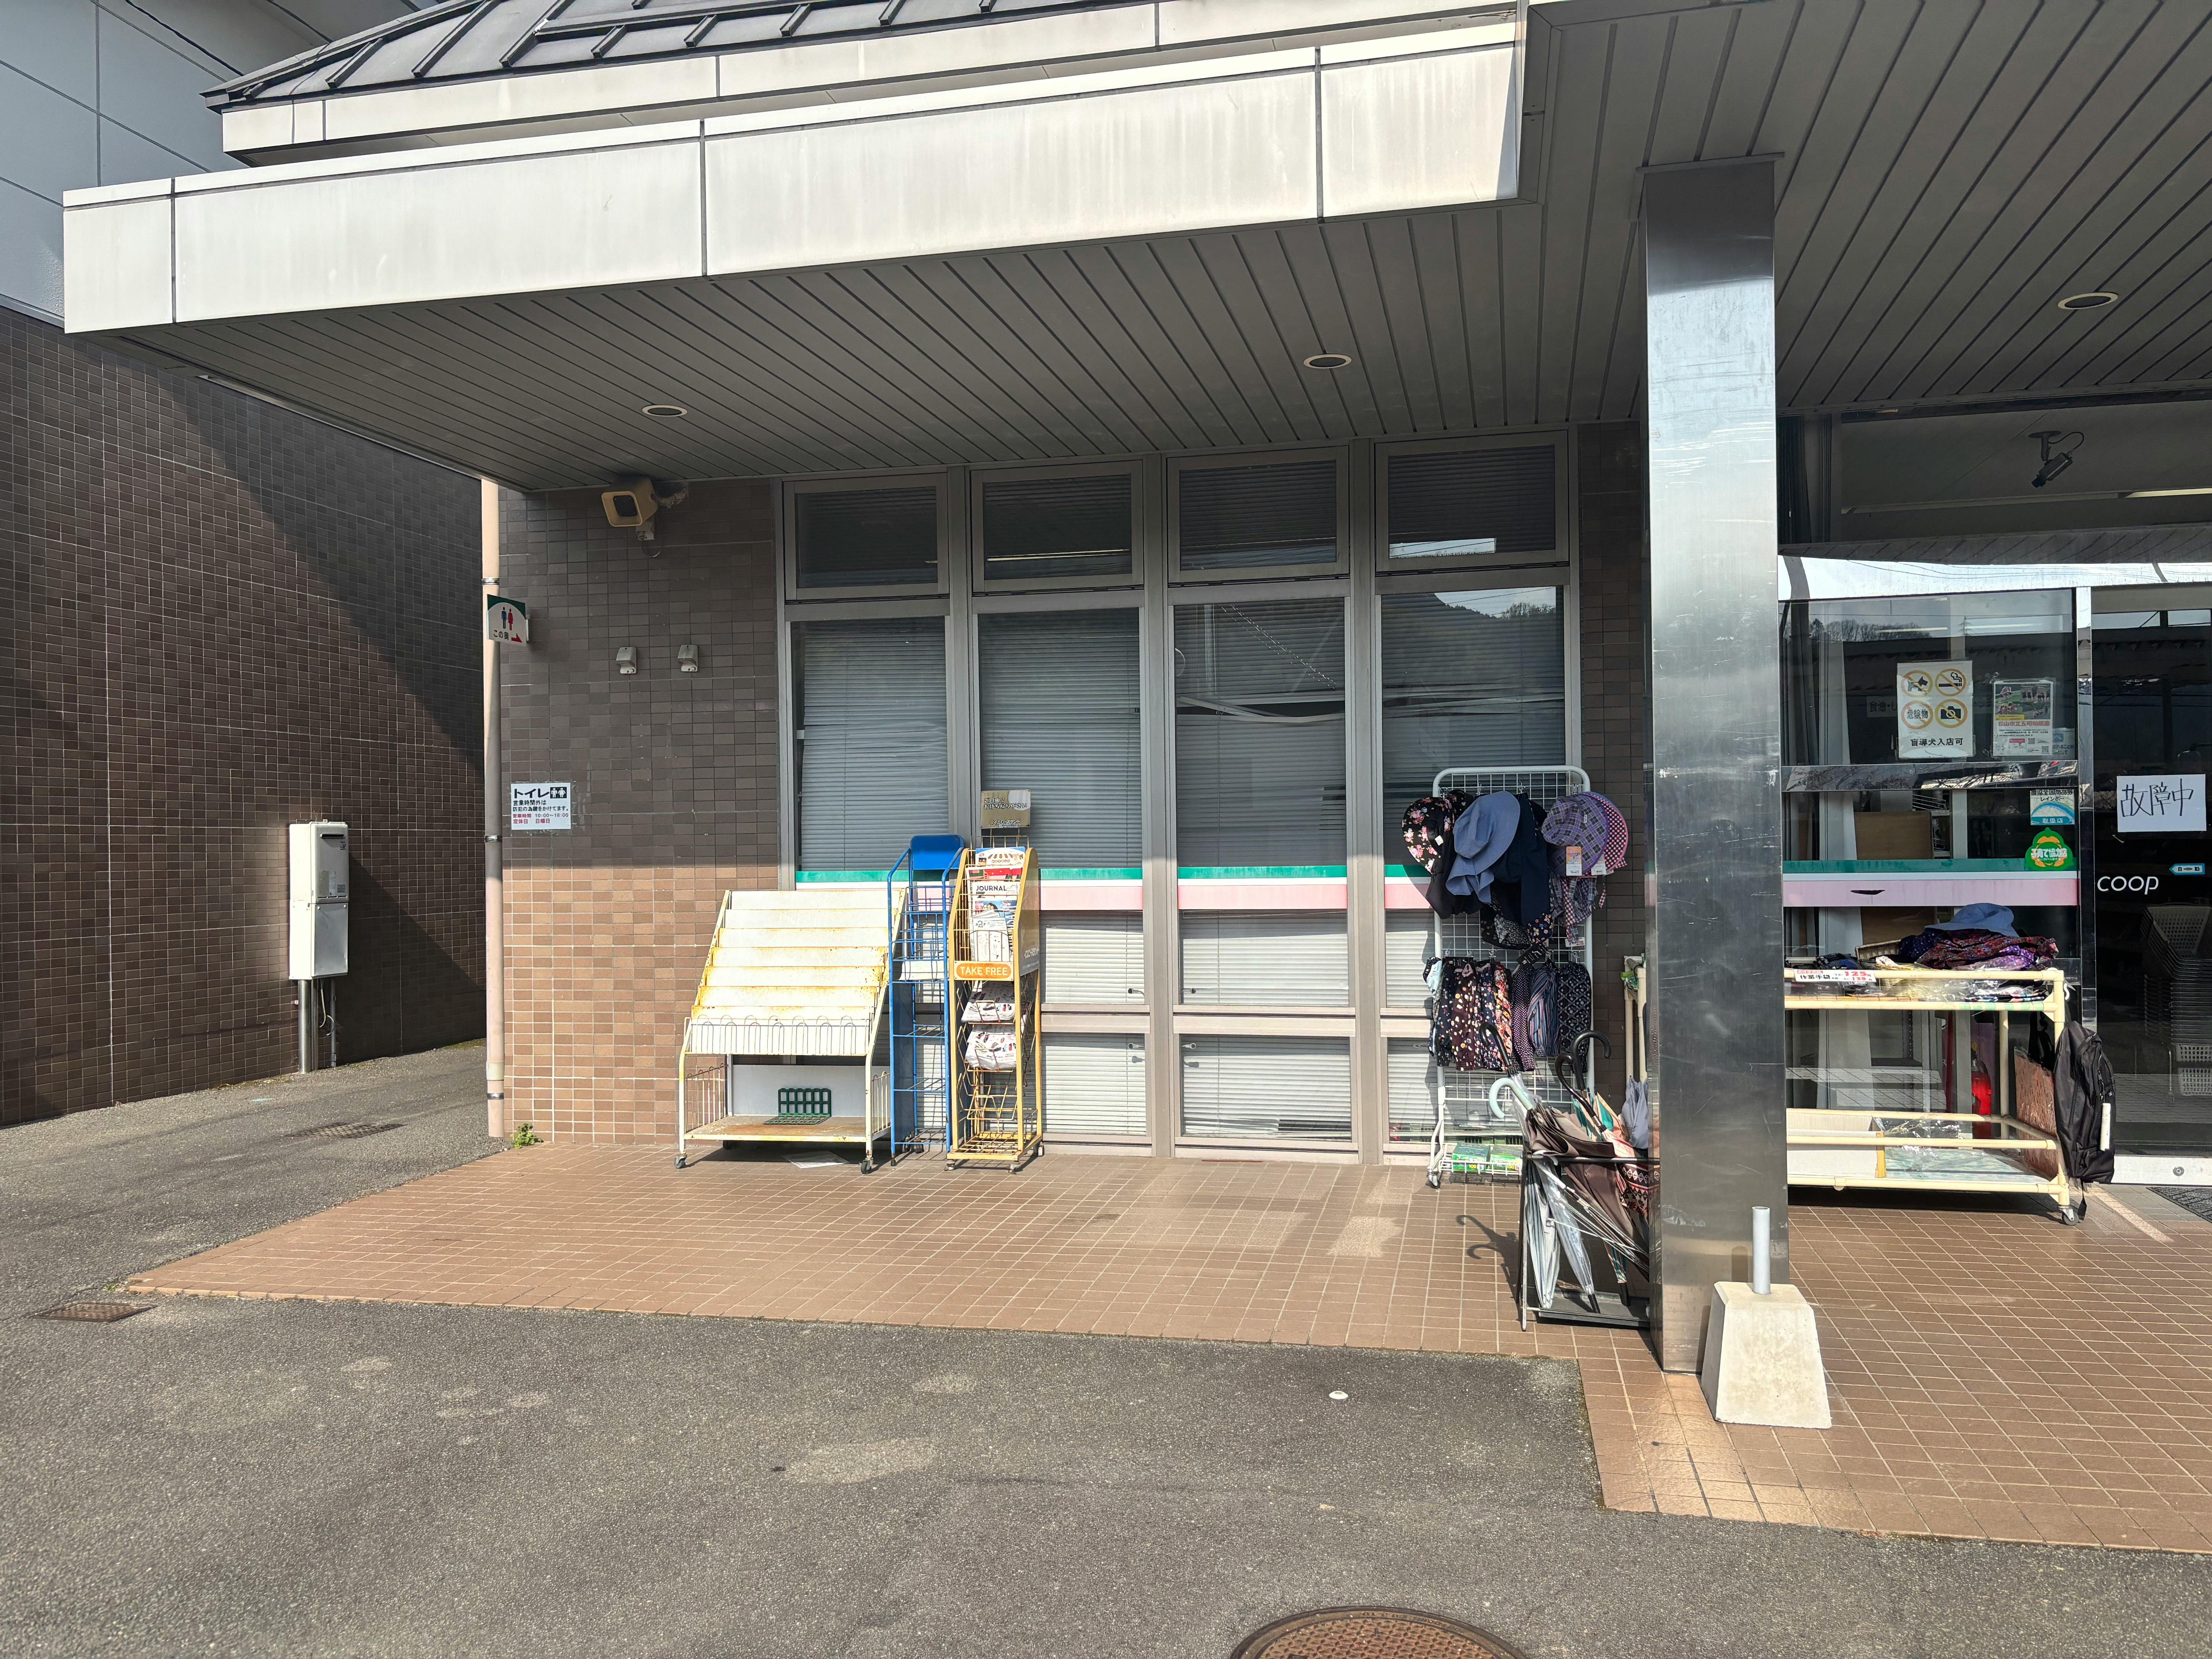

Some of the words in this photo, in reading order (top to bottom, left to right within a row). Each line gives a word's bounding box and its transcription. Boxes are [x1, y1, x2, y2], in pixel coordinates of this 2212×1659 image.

[494, 630, 509, 640] この奥
[1907, 709, 1928, 719] 危険物
[1910, 738, 1963, 746] 盲導犬入店可
[514, 788, 550, 799] トイレ
[2120, 778, 2194, 817] 故障中
[2097, 876, 2159, 895] coop
[960, 967, 982, 975] TAKE
[986, 967, 1008, 976] FREE
